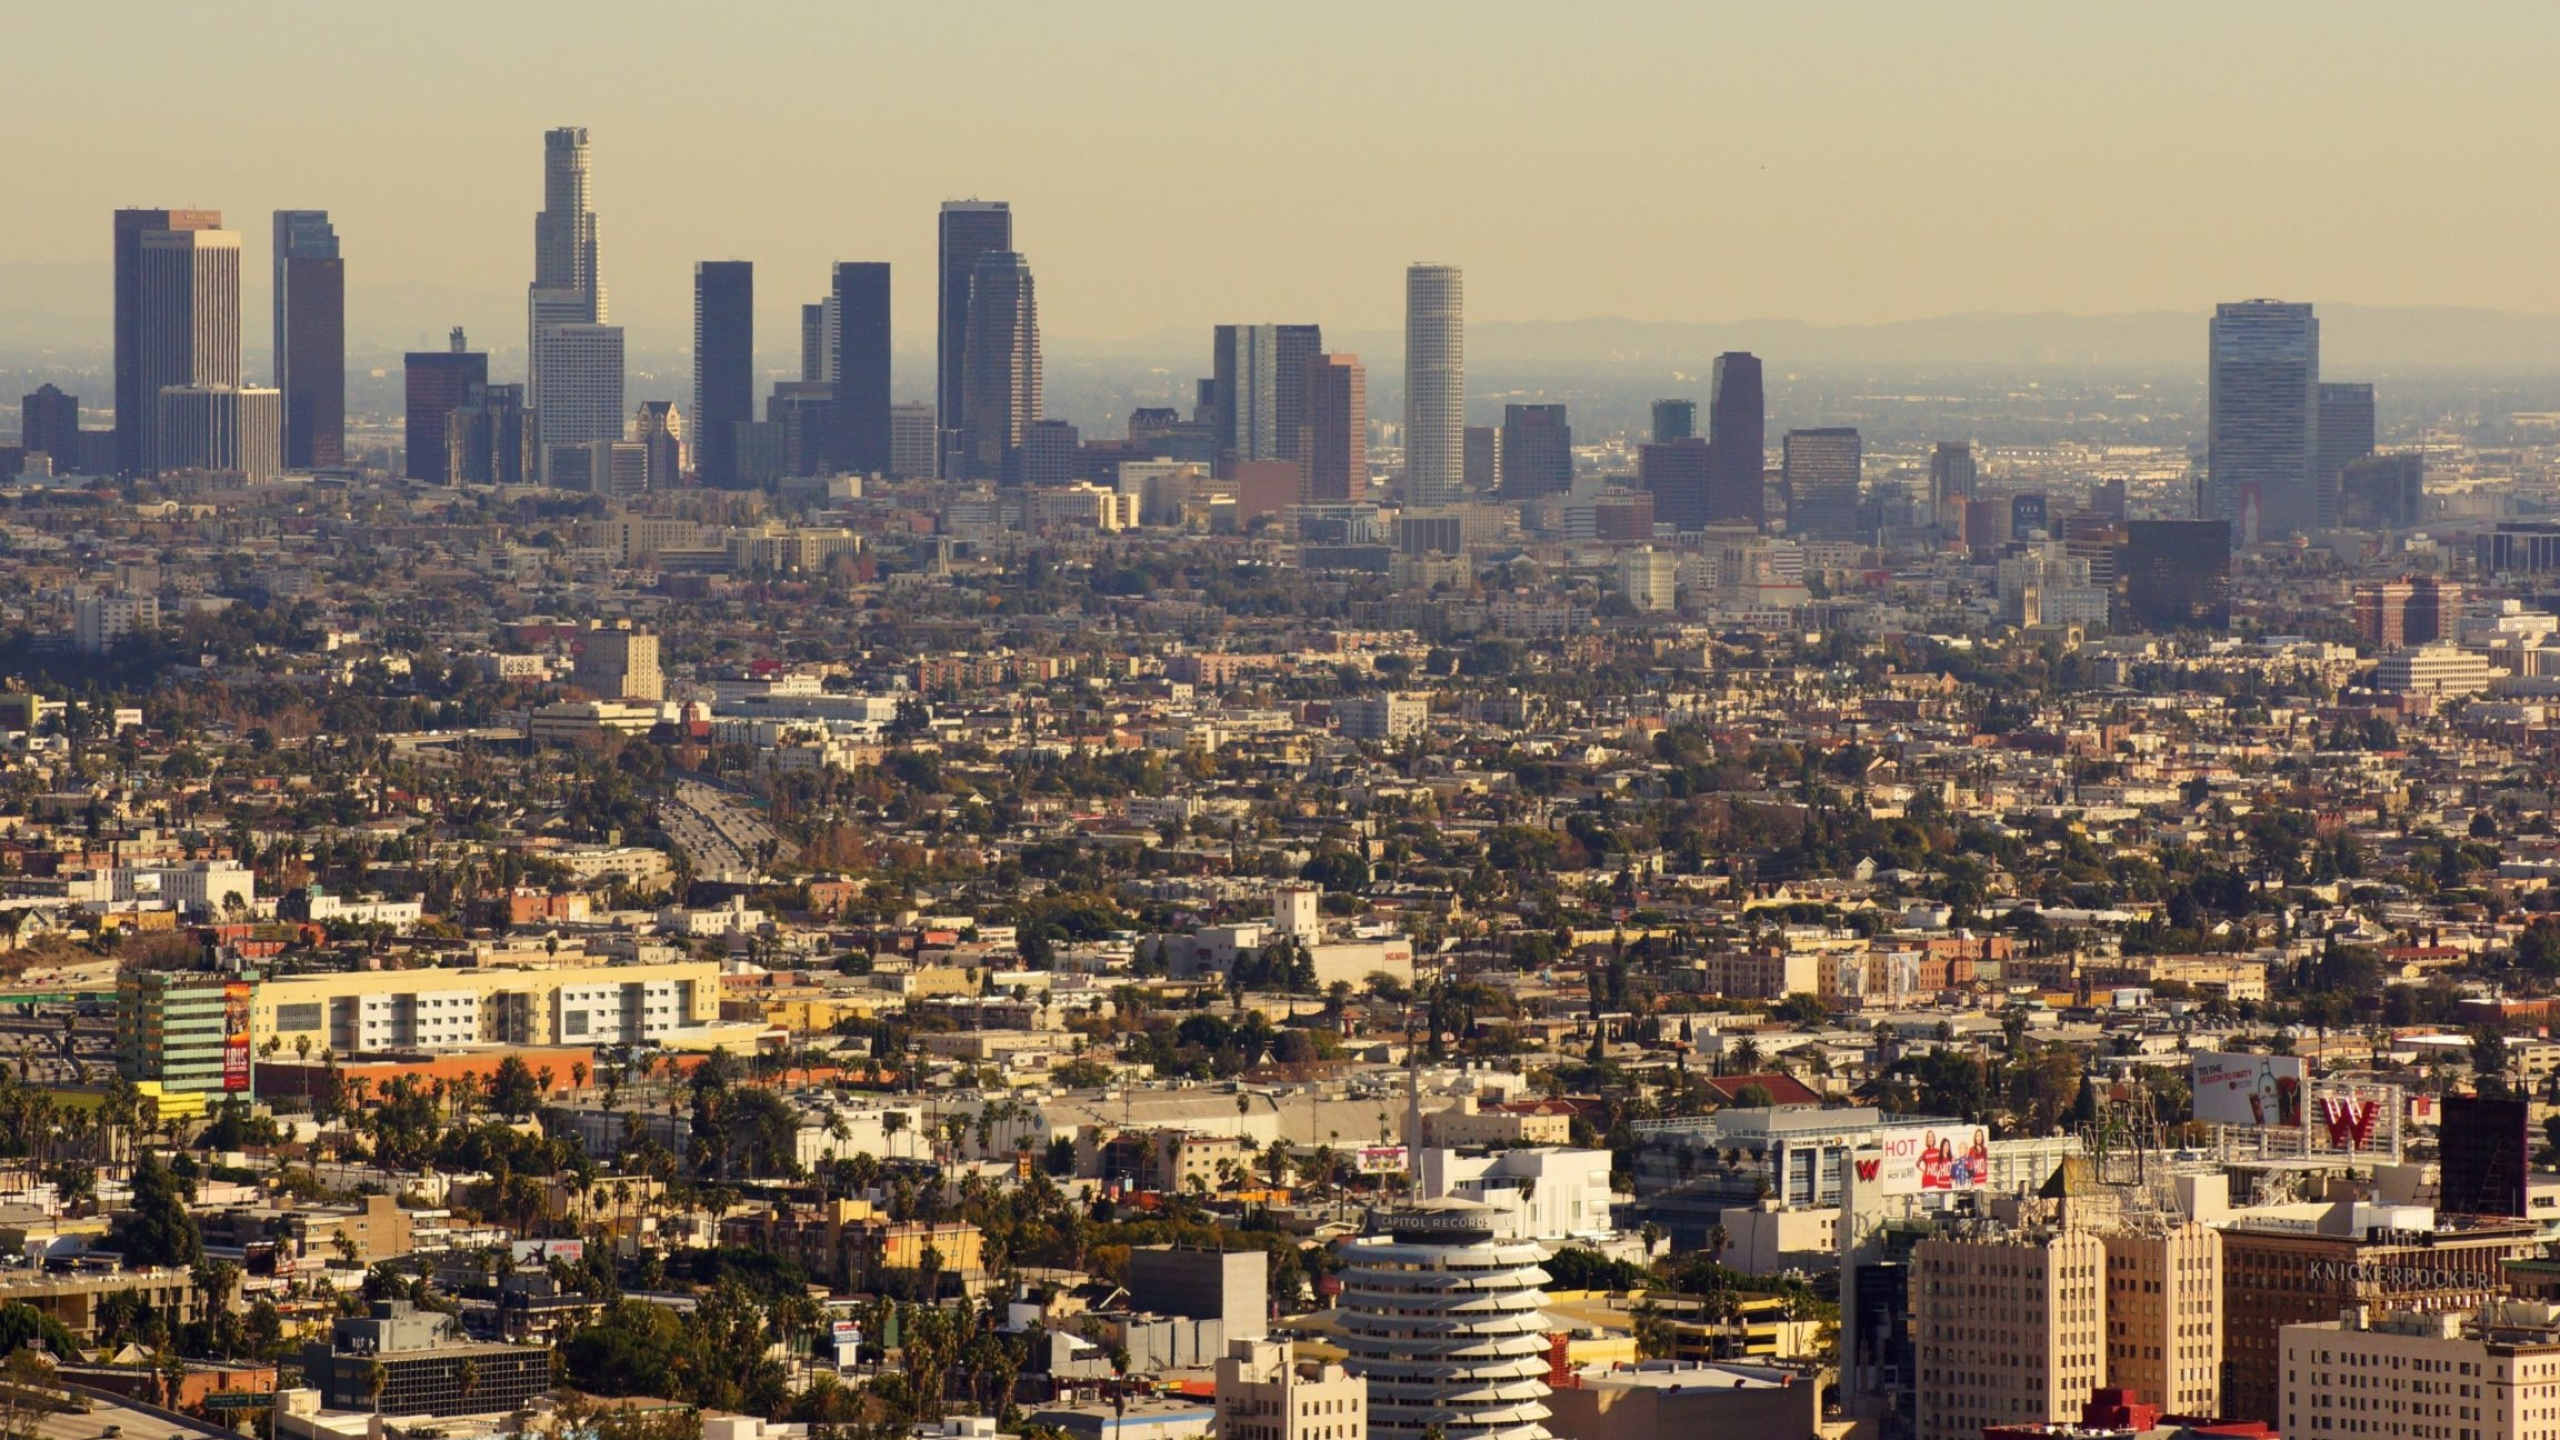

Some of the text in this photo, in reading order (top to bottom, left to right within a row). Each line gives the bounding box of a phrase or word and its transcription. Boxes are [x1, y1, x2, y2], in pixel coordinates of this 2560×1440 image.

[2232, 1068, 2252, 1079] PARTY
[2320, 1097, 2378, 1151] W
[1885, 1139, 1917, 1156] HOT
[1855, 1158, 1880, 1183] W
[1381, 1216, 1427, 1228] CAPITOL
[1432, 1217, 1491, 1228] RECORDS
[2382, 1228, 2418, 1247] THE
[2310, 1261, 2490, 1290] KNICKERBOCKER
